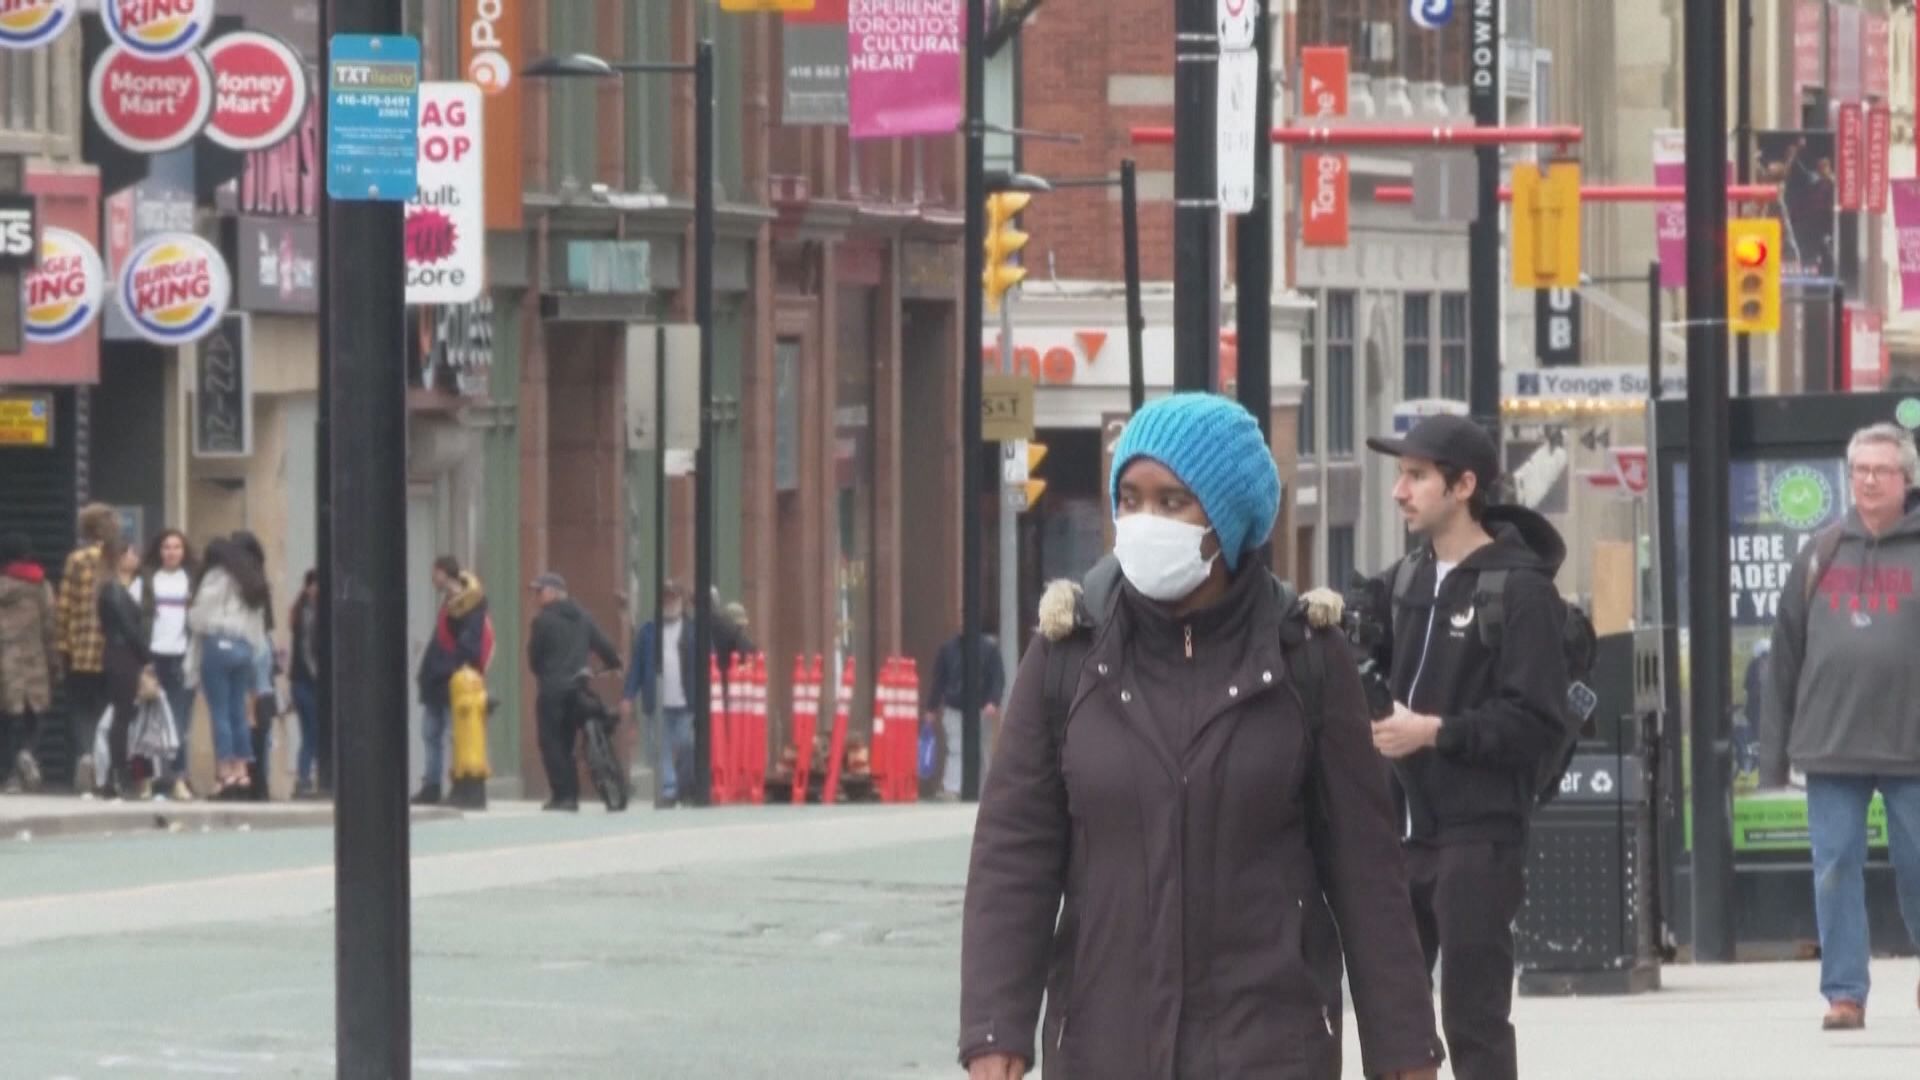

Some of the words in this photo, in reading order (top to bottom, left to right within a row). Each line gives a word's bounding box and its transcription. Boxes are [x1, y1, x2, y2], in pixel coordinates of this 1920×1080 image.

[848, 0, 960, 16] EXPERIENCE
[849, 17, 959, 34] TORONTO'S
[862, 35, 960, 53] CULTURAL
[852, 53, 916, 71] HEART
[111, 71, 192, 98] Money
[120, 94, 176, 114] Mart
[217, 94, 271, 114] Mart
[421, 101, 467, 127] AG
[416, 135, 471, 163] OP
[410, 185, 461, 206] dult
[134, 258, 208, 290] BURGER
[29, 272, 85, 305] ING
[136, 276, 210, 319] KING
[1544, 375, 1613, 397] Yonge
[1620, 374, 1686, 392] Sues
[1560, 771, 1583, 793] er
